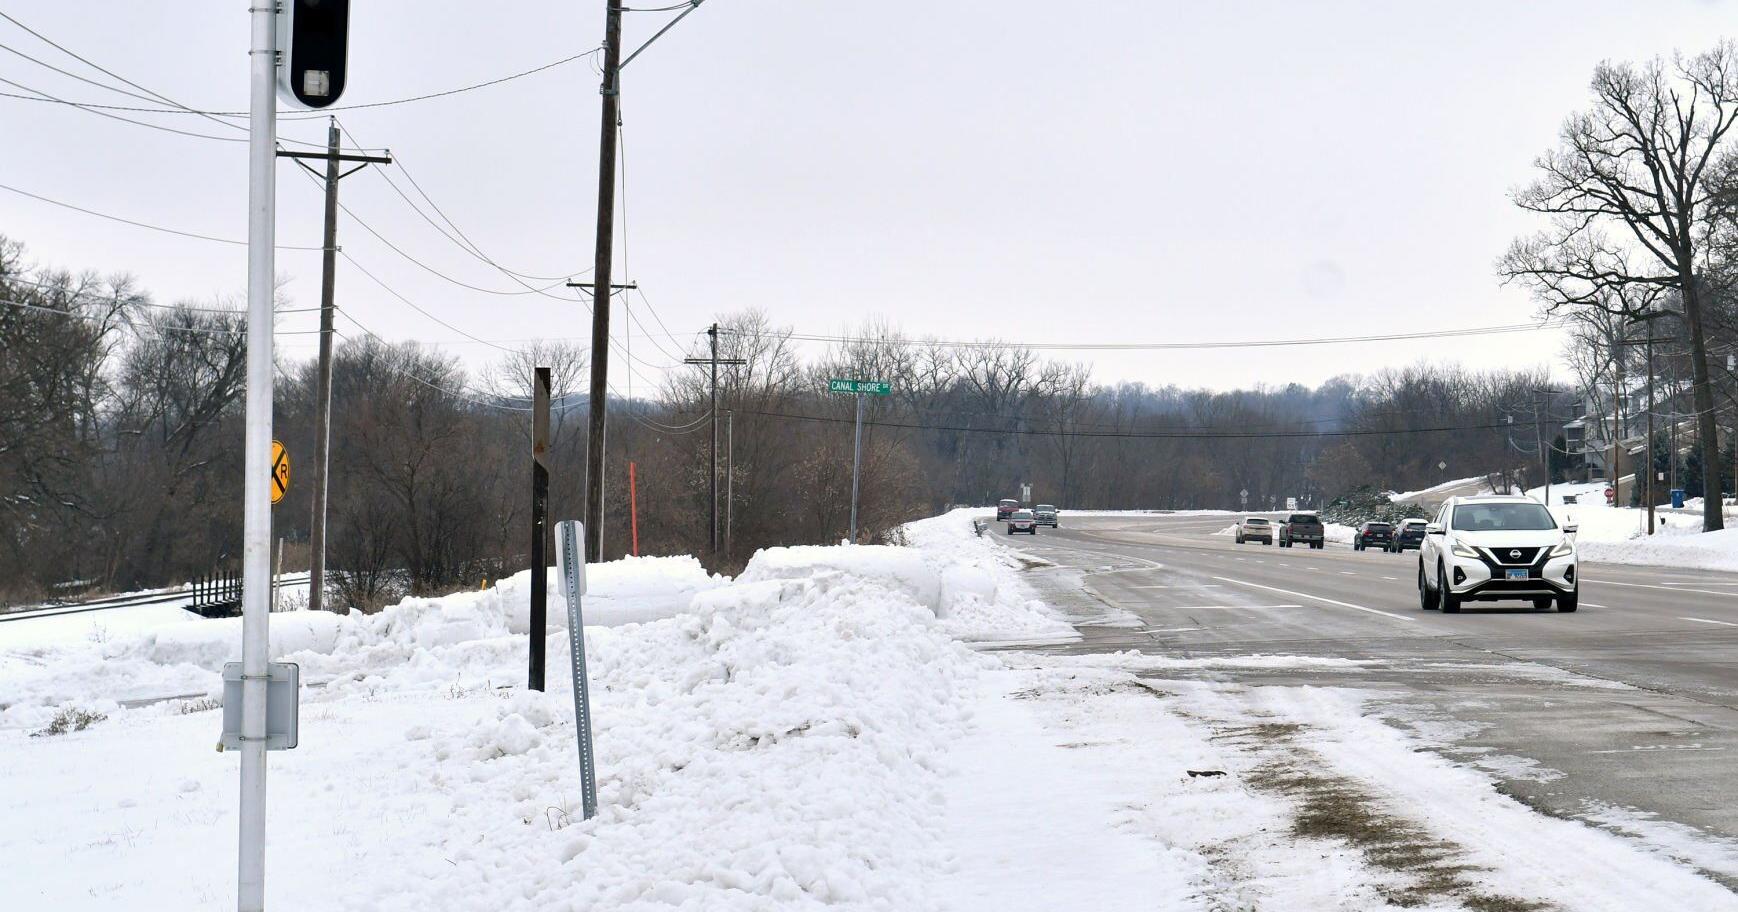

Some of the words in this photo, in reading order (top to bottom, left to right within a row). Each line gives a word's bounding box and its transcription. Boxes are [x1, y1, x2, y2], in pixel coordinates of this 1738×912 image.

[831, 380, 854, 391] CANAL
[856, 382, 881, 392] SHORE
[280, 463, 288, 479] R
